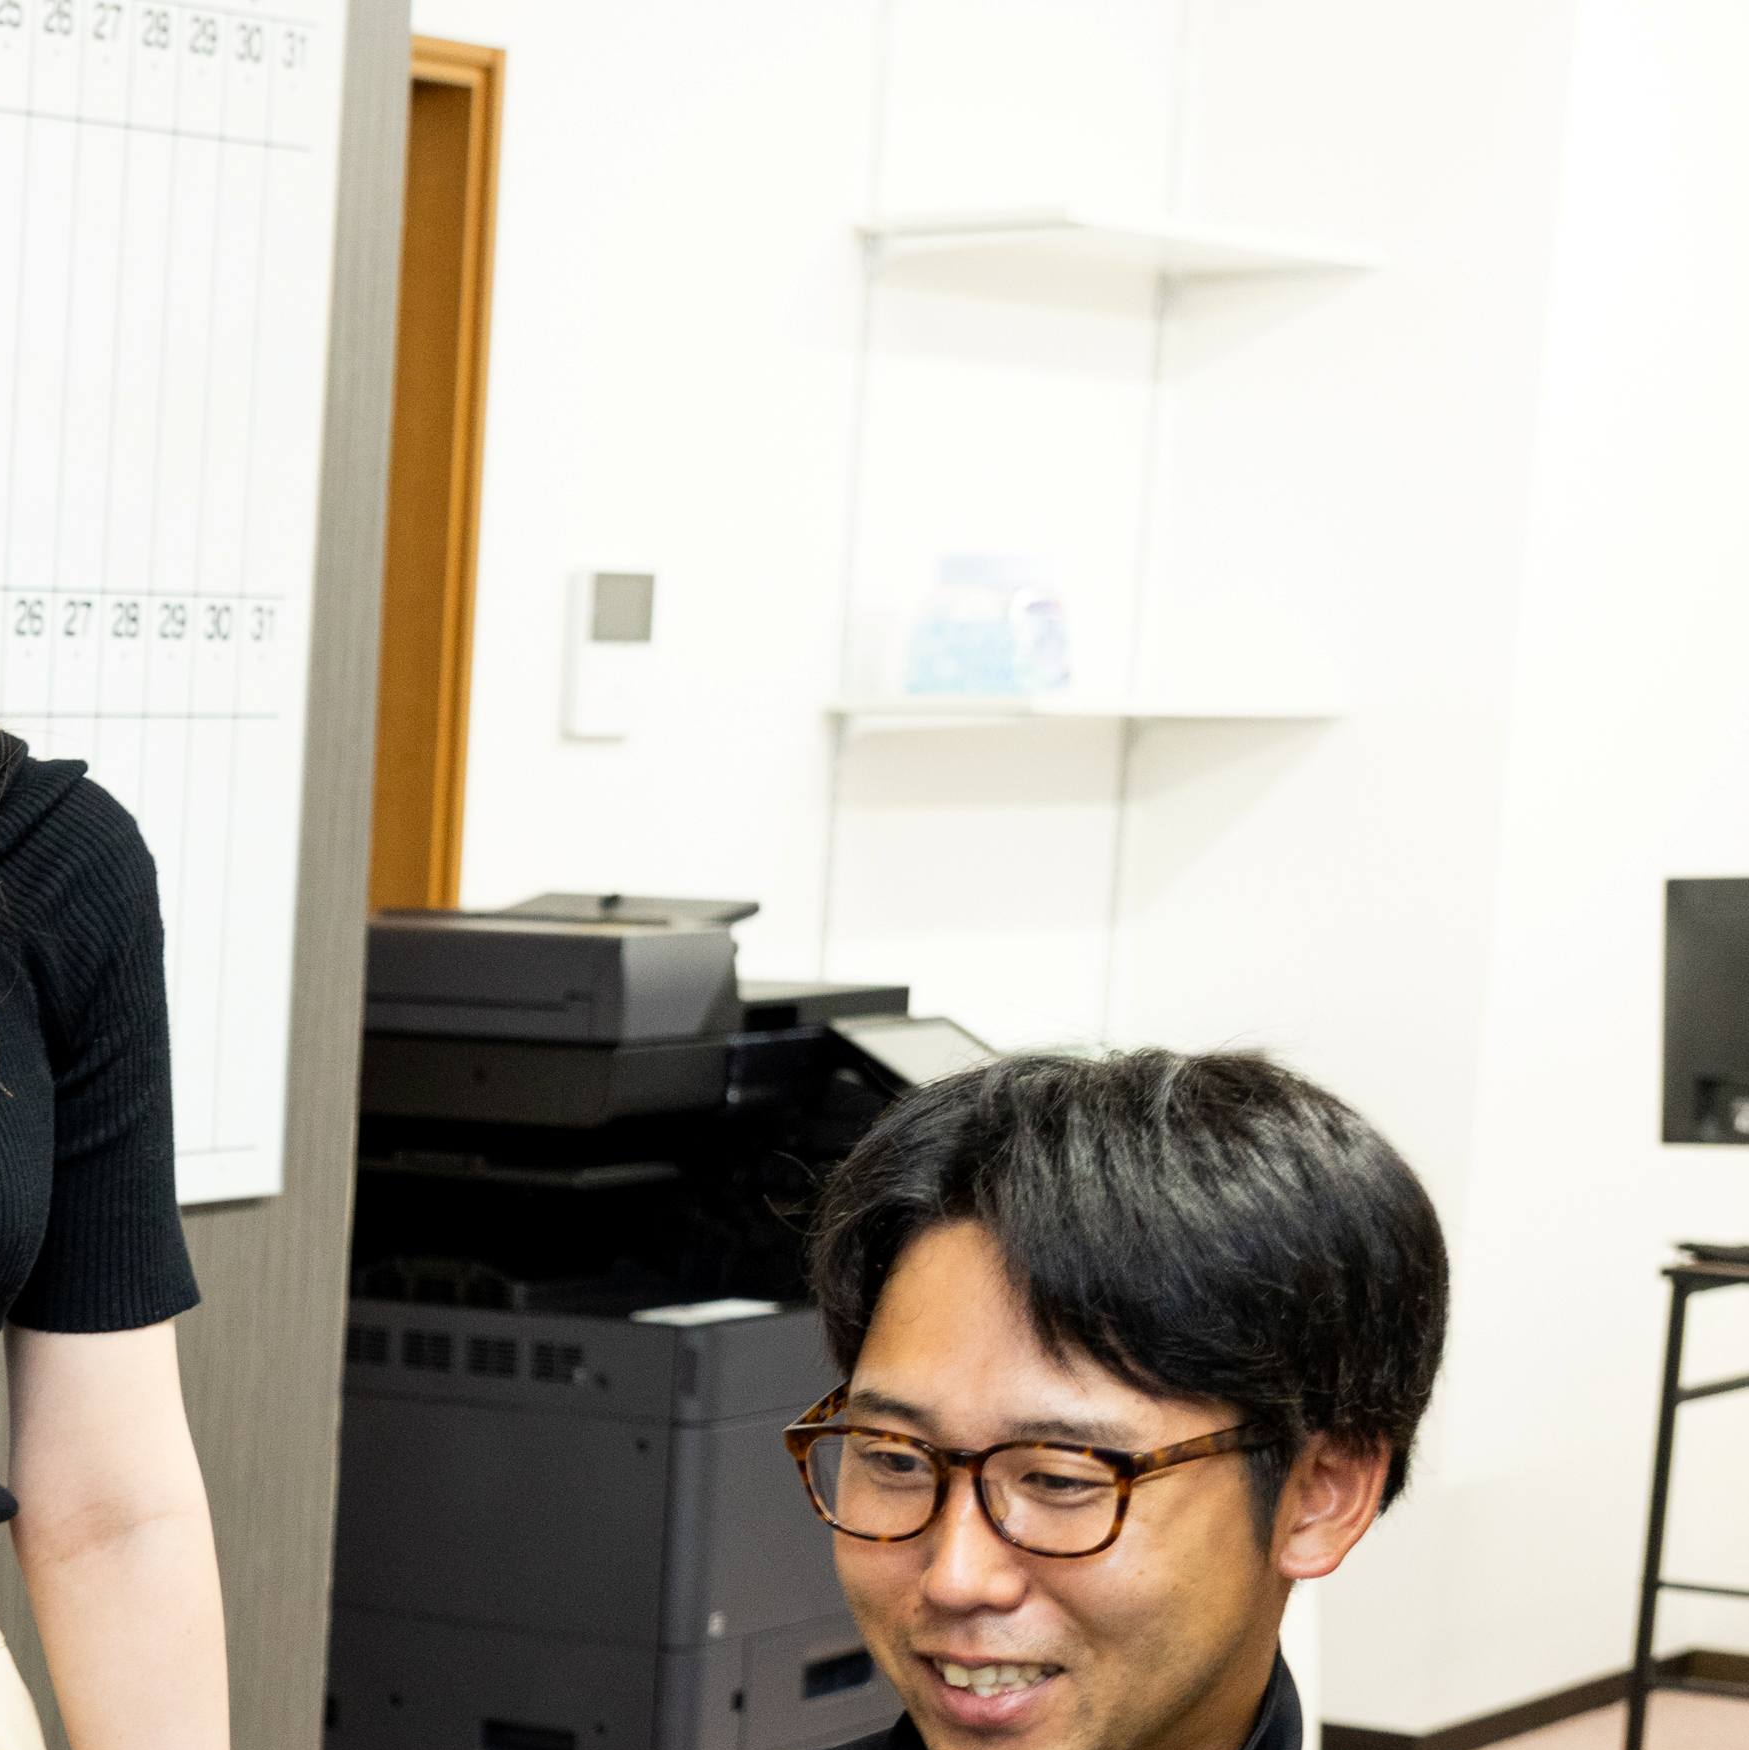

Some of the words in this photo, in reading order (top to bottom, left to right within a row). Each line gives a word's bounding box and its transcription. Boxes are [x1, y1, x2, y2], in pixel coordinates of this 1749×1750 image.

[91, 1, 124, 43] 27
[140, 8, 171, 50] 28
[188, 15, 219, 57] 29
[234, 23, 264, 65] 30
[281, 30, 309, 71] 31
[13, 599, 45, 638] 26
[63, 600, 93, 638] 27
[111, 601, 140, 640] 28
[158, 603, 188, 641] 29
[204, 604, 233, 642] 30
[249, 605, 276, 643] 31
